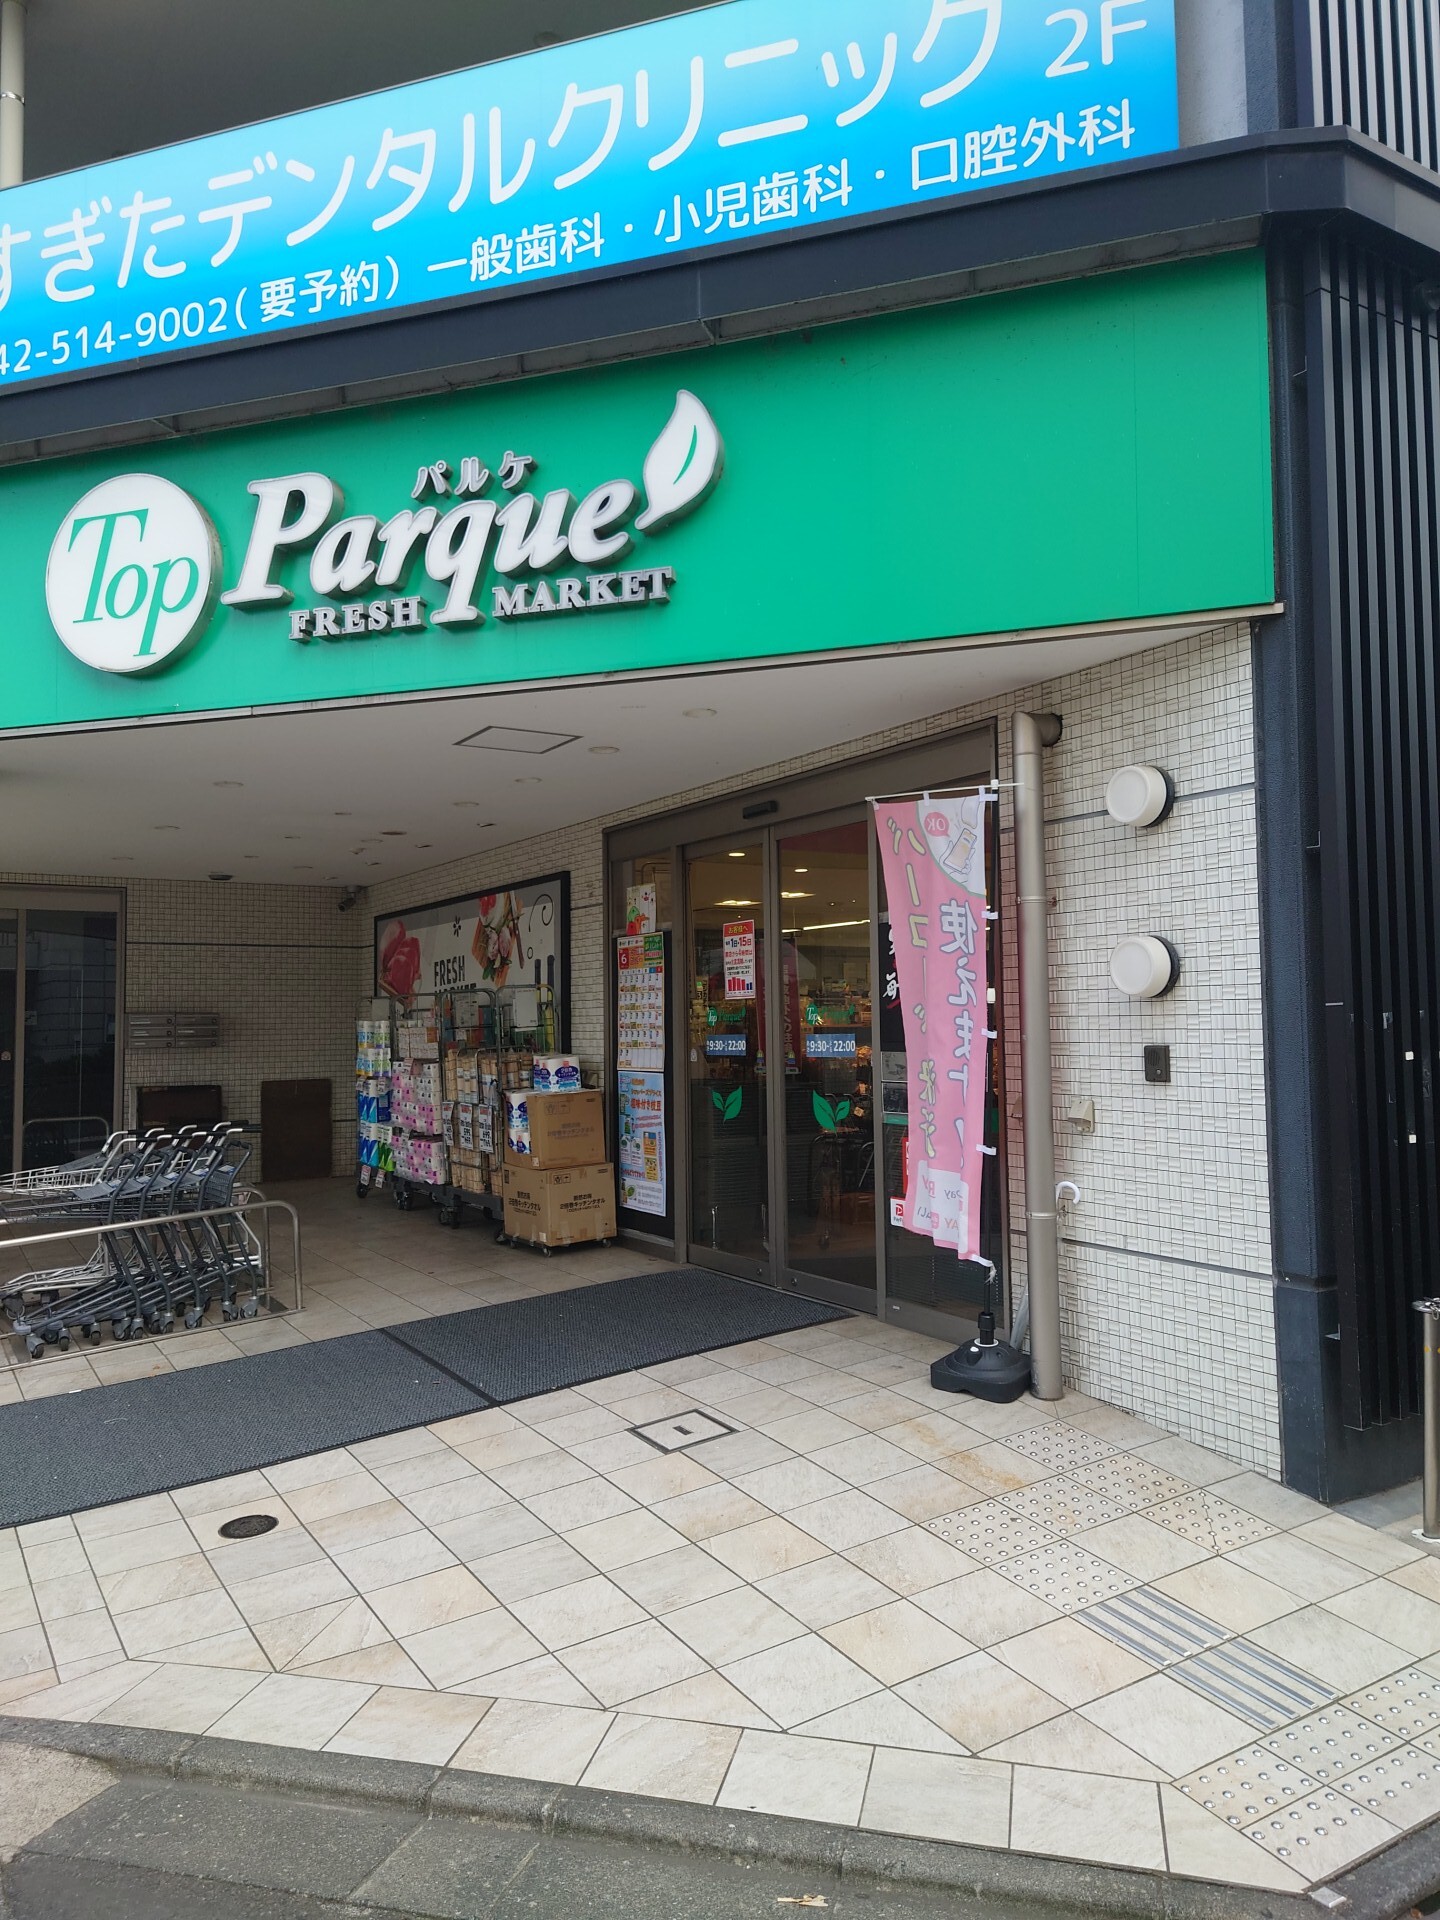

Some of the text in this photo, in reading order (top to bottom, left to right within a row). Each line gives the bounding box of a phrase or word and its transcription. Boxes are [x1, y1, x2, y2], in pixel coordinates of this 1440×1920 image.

[1045, 0, 1148, 78] 2F
[414, 450, 537, 500] パルケ
[221, 471, 641, 625] Parque
[67, 508, 199, 657] Top
[289, 567, 677, 642] FRESH MARKET
[434, 955, 466, 987] FRESH
[728, 1040, 746, 1051] 22:00
[834, 1040, 856, 1052] 22:00
